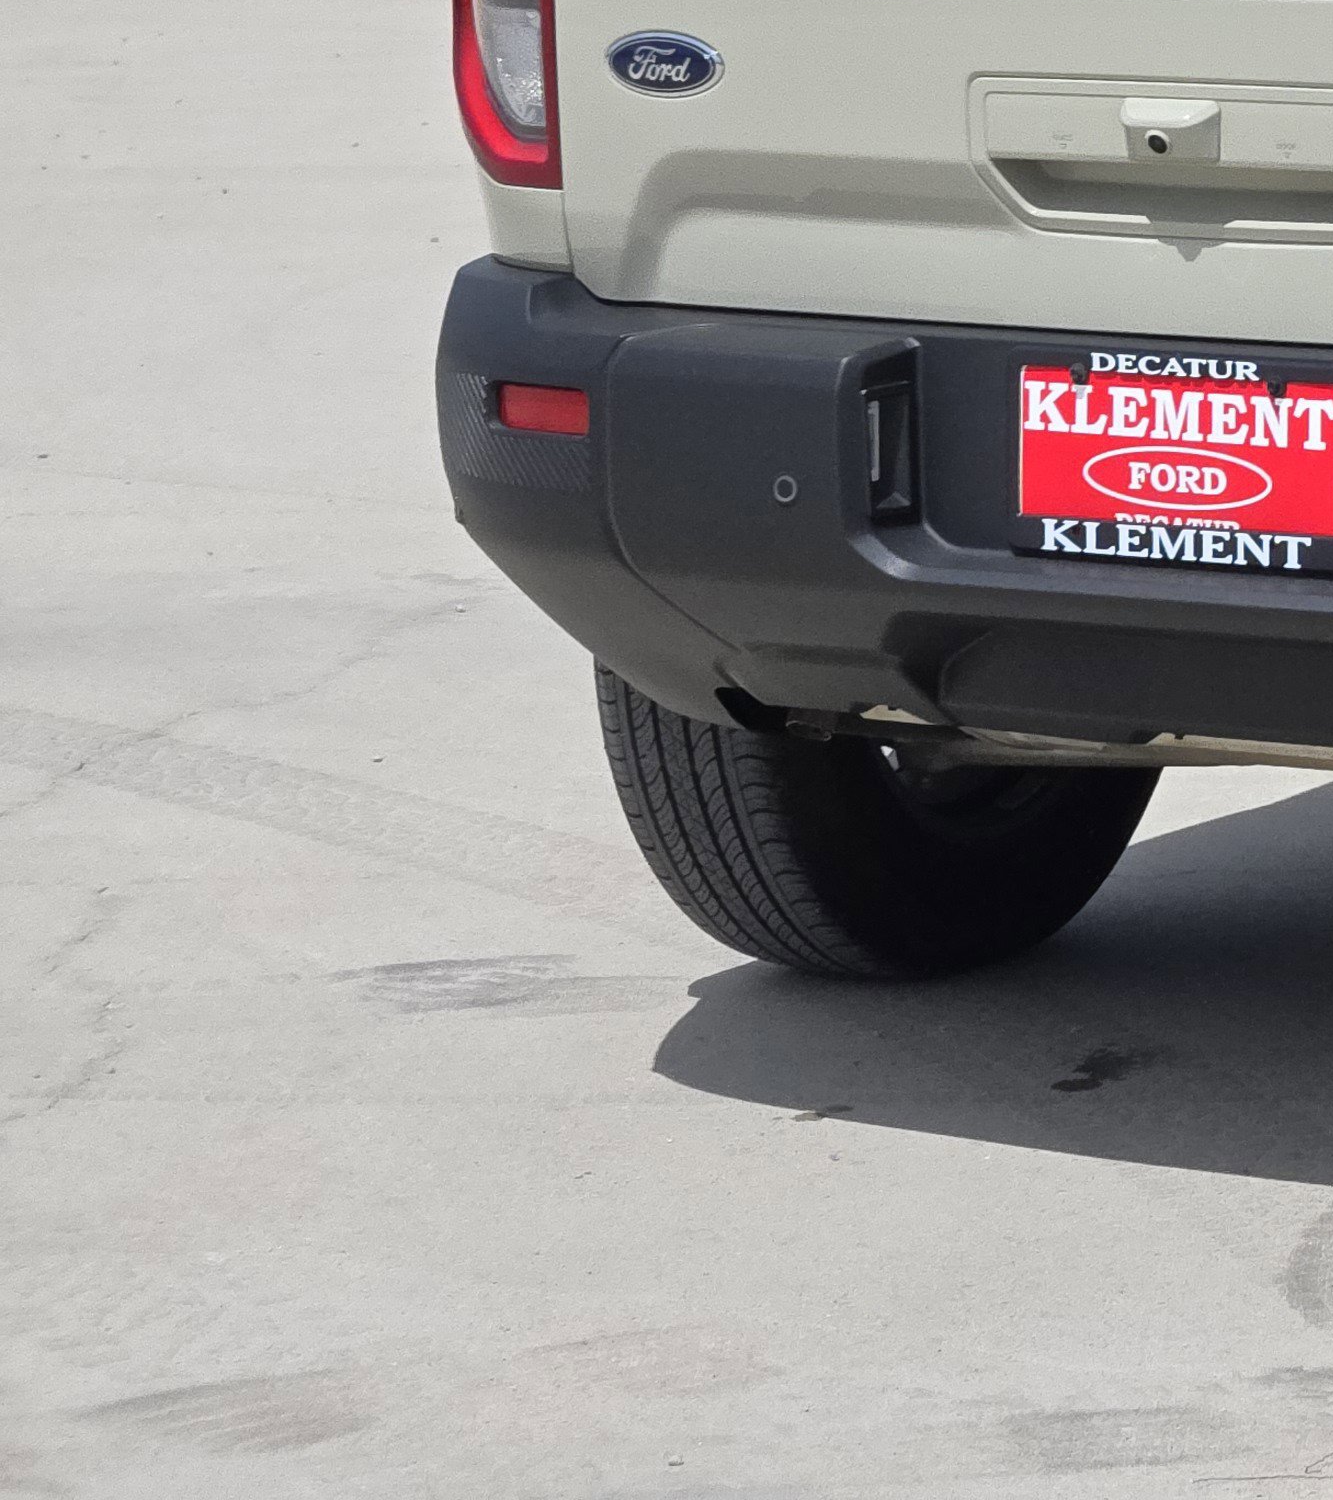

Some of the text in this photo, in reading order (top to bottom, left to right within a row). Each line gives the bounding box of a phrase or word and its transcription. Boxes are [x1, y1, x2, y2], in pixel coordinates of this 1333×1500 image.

[628, 45, 692, 83] Ford
[1090, 351, 1261, 382] DECATUR
[1127, 461, 1228, 496] FORD
[1040, 518, 1313, 570] KLEMENT
